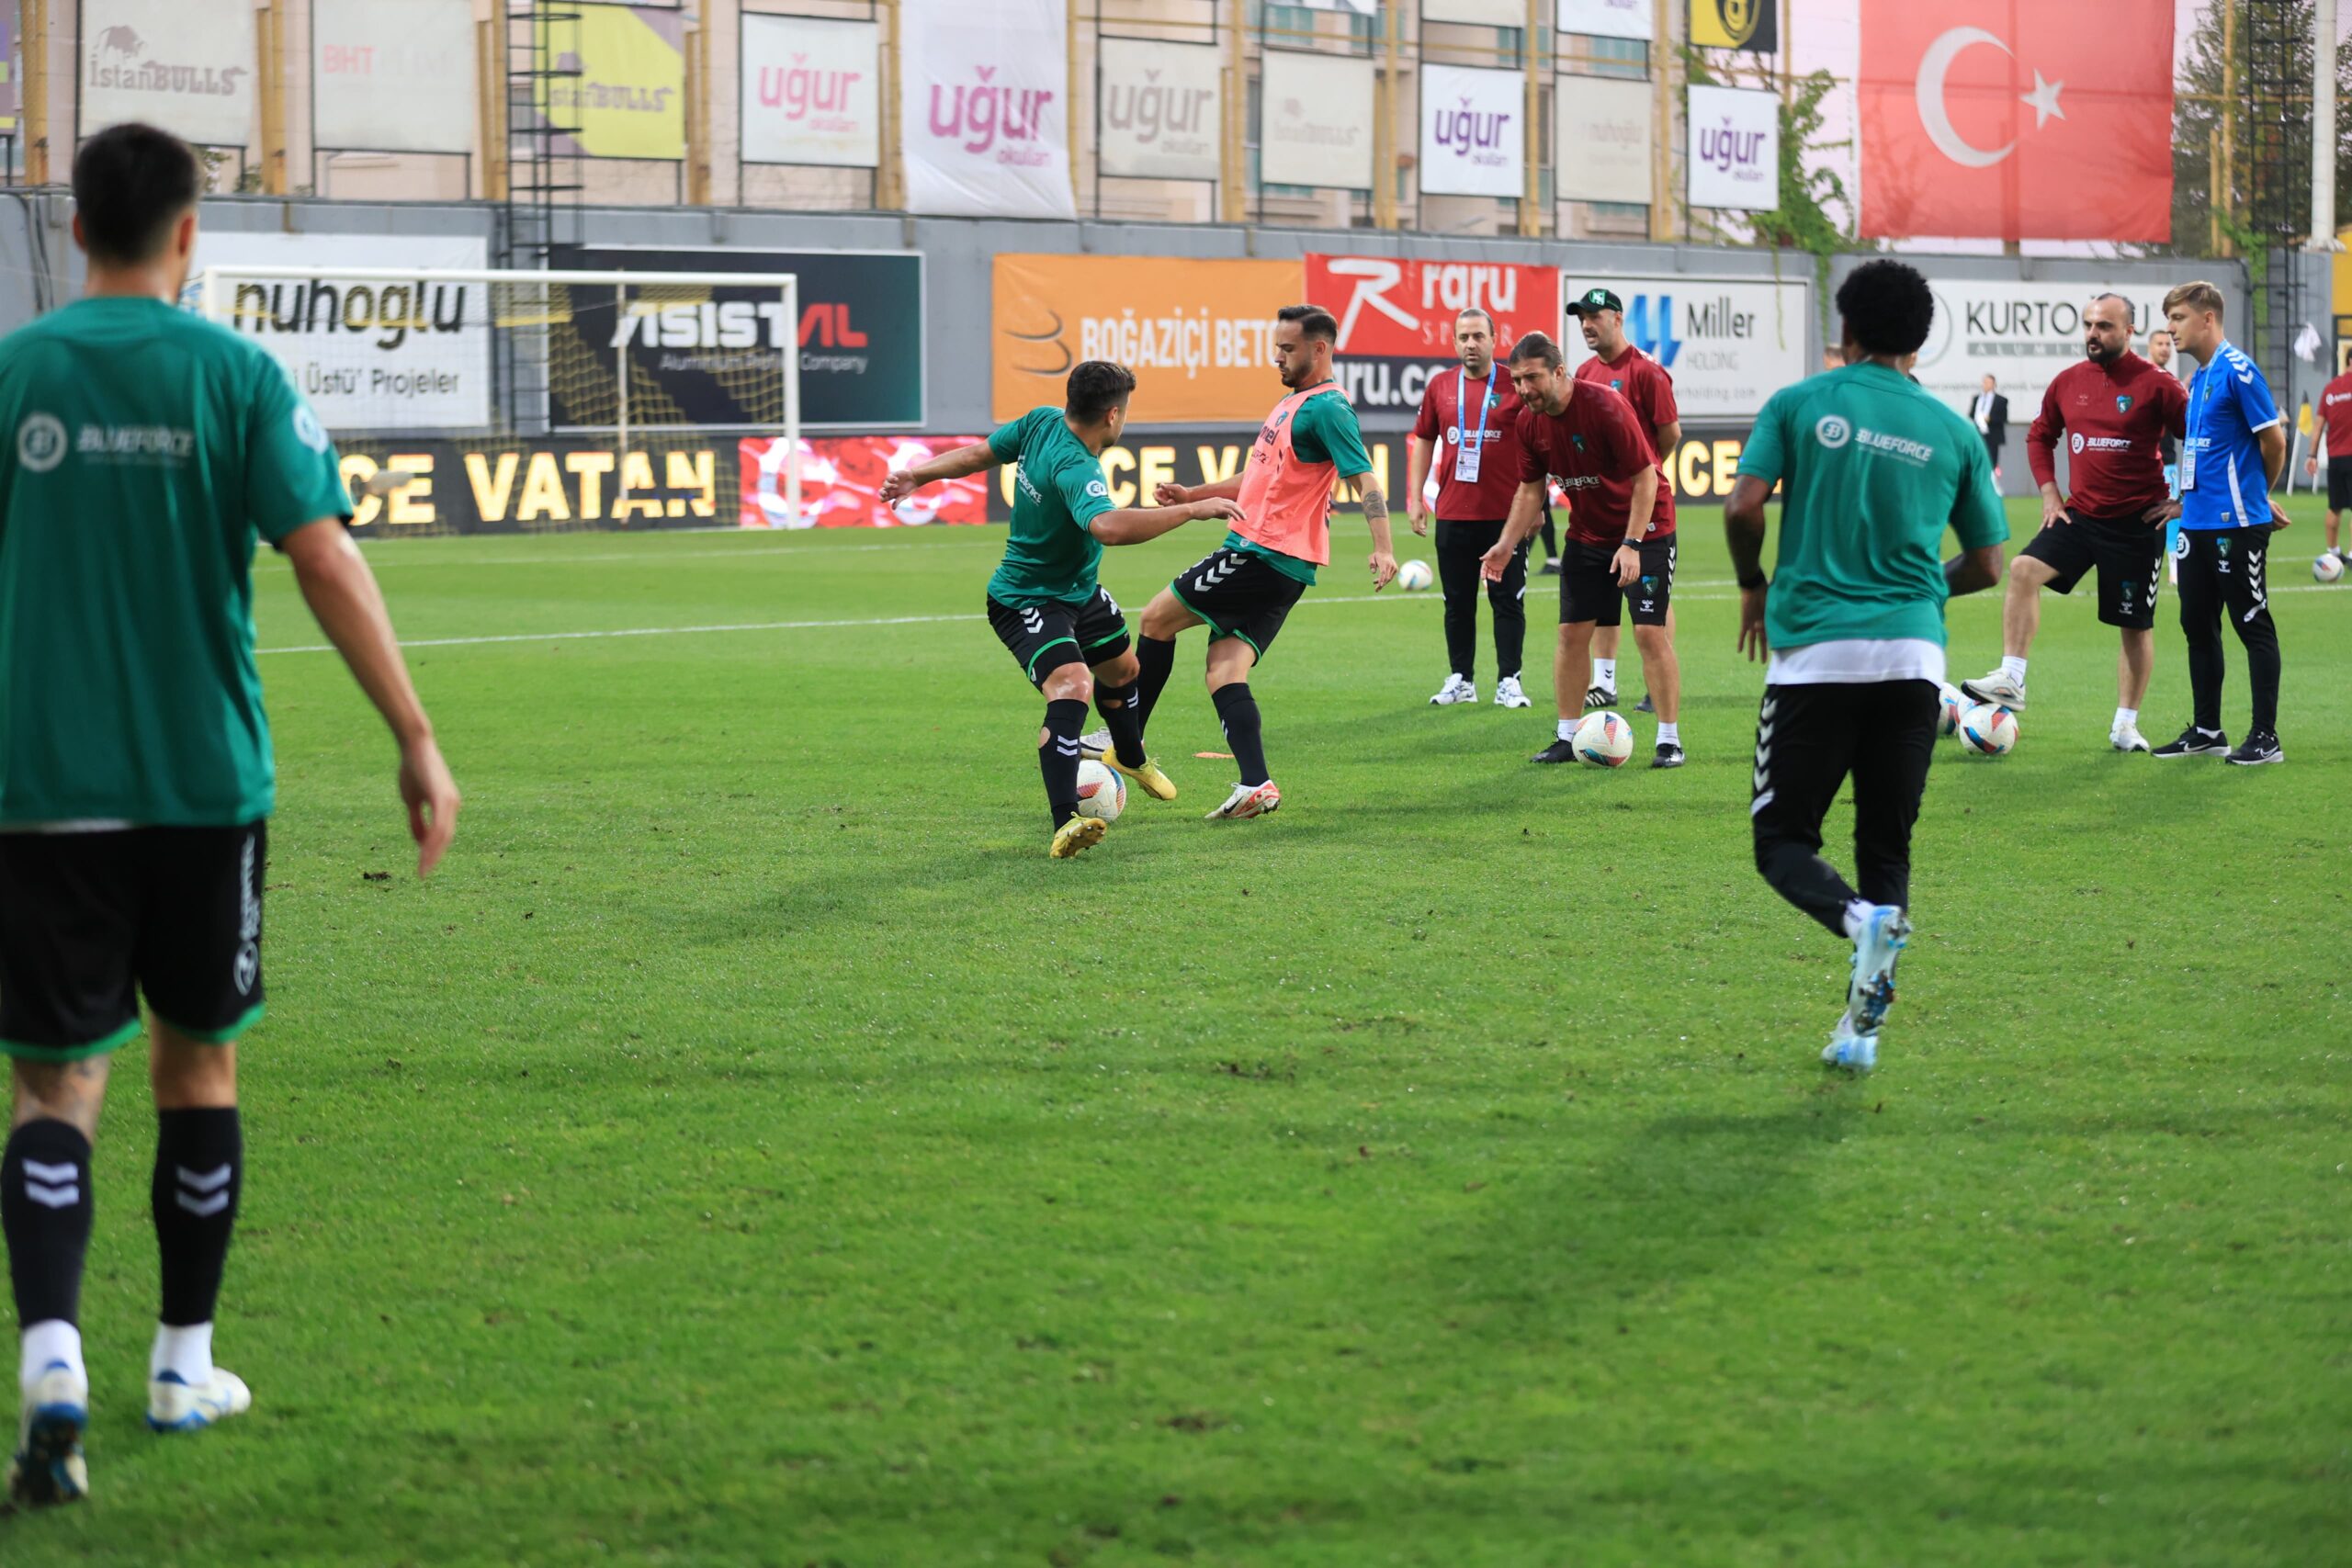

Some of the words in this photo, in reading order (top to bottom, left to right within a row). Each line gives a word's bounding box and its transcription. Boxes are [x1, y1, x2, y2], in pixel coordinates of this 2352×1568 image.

[322, 44, 377, 73] BHT
[760, 51, 862, 121] uğur
[929, 64, 1053, 153] uğur
[1108, 69, 1213, 143] uğur
[1435, 96, 1510, 156] uğur
[1701, 116, 1765, 172] uğur
[1422, 264, 1517, 312] raru
[609, 301, 868, 348] ASISTAL
[1688, 297, 1756, 338] Miller
[800, 353, 868, 374] Company
[1080, 306, 1209, 379] BOĞAZİÇİ
[1687, 353, 1739, 371] HOLDING
[371, 369, 460, 397] Projeler
[1855, 427, 1933, 462] BLUEFORCE
[464, 451, 717, 522] VATAN
